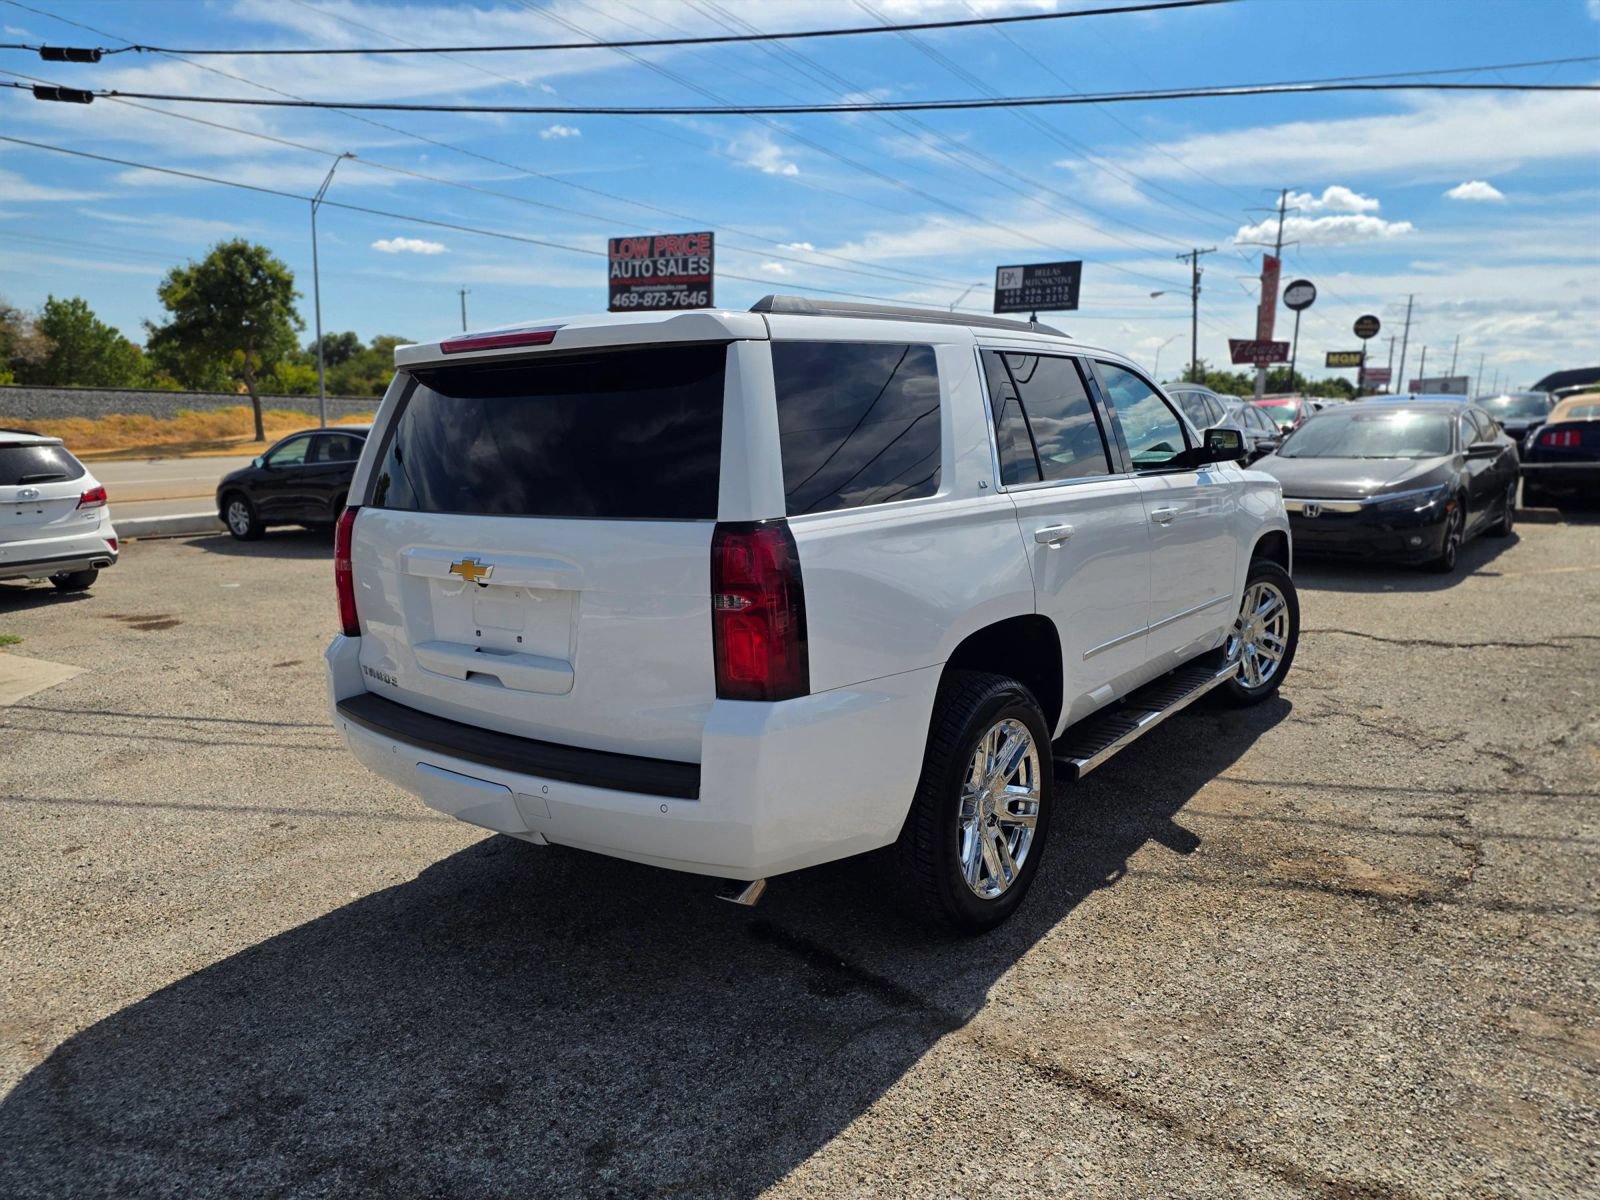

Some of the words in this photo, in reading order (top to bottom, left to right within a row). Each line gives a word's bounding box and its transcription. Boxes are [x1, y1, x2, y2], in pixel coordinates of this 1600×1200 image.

[610, 238, 651, 260] LOW
[654, 233, 711, 257] PRICE
[611, 260, 653, 278] AUTO
[657, 257, 710, 276] SALES
[612, 291, 708, 307] 469-873-7646
